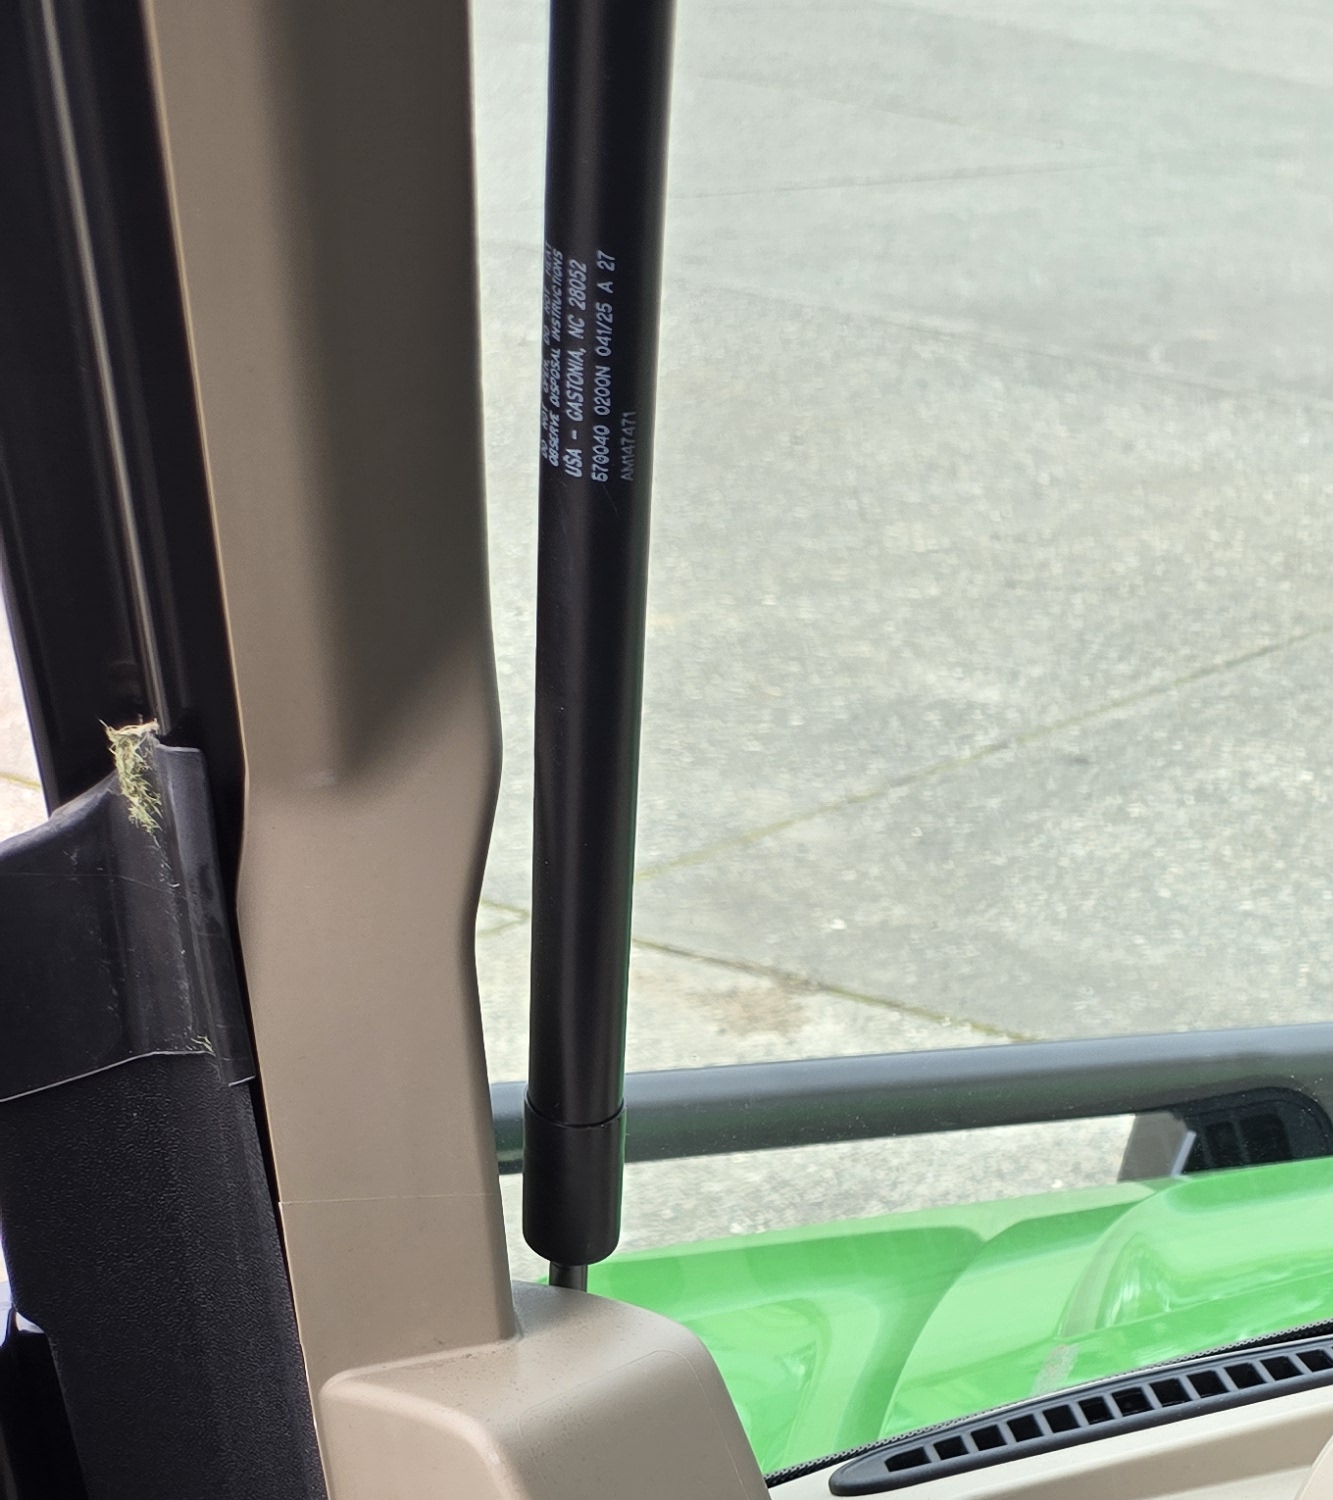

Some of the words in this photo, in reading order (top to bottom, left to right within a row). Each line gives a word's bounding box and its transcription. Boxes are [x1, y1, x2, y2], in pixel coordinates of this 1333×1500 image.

[568, 259, 587, 311] 28052
[597, 280, 614, 294] A
[598, 250, 616, 272] 27
[551, 249, 563, 342] INSTRUCTIONS
[567, 315, 586, 340] NC
[595, 301, 613, 356] 041/25
[550, 348, 561, 408] DISPOSAL
[565, 347, 587, 422] GASTONIA,
[594, 365, 612, 416] 0200N
[549, 410, 560, 466] OBSERVE
[564, 448, 583, 478] USA
